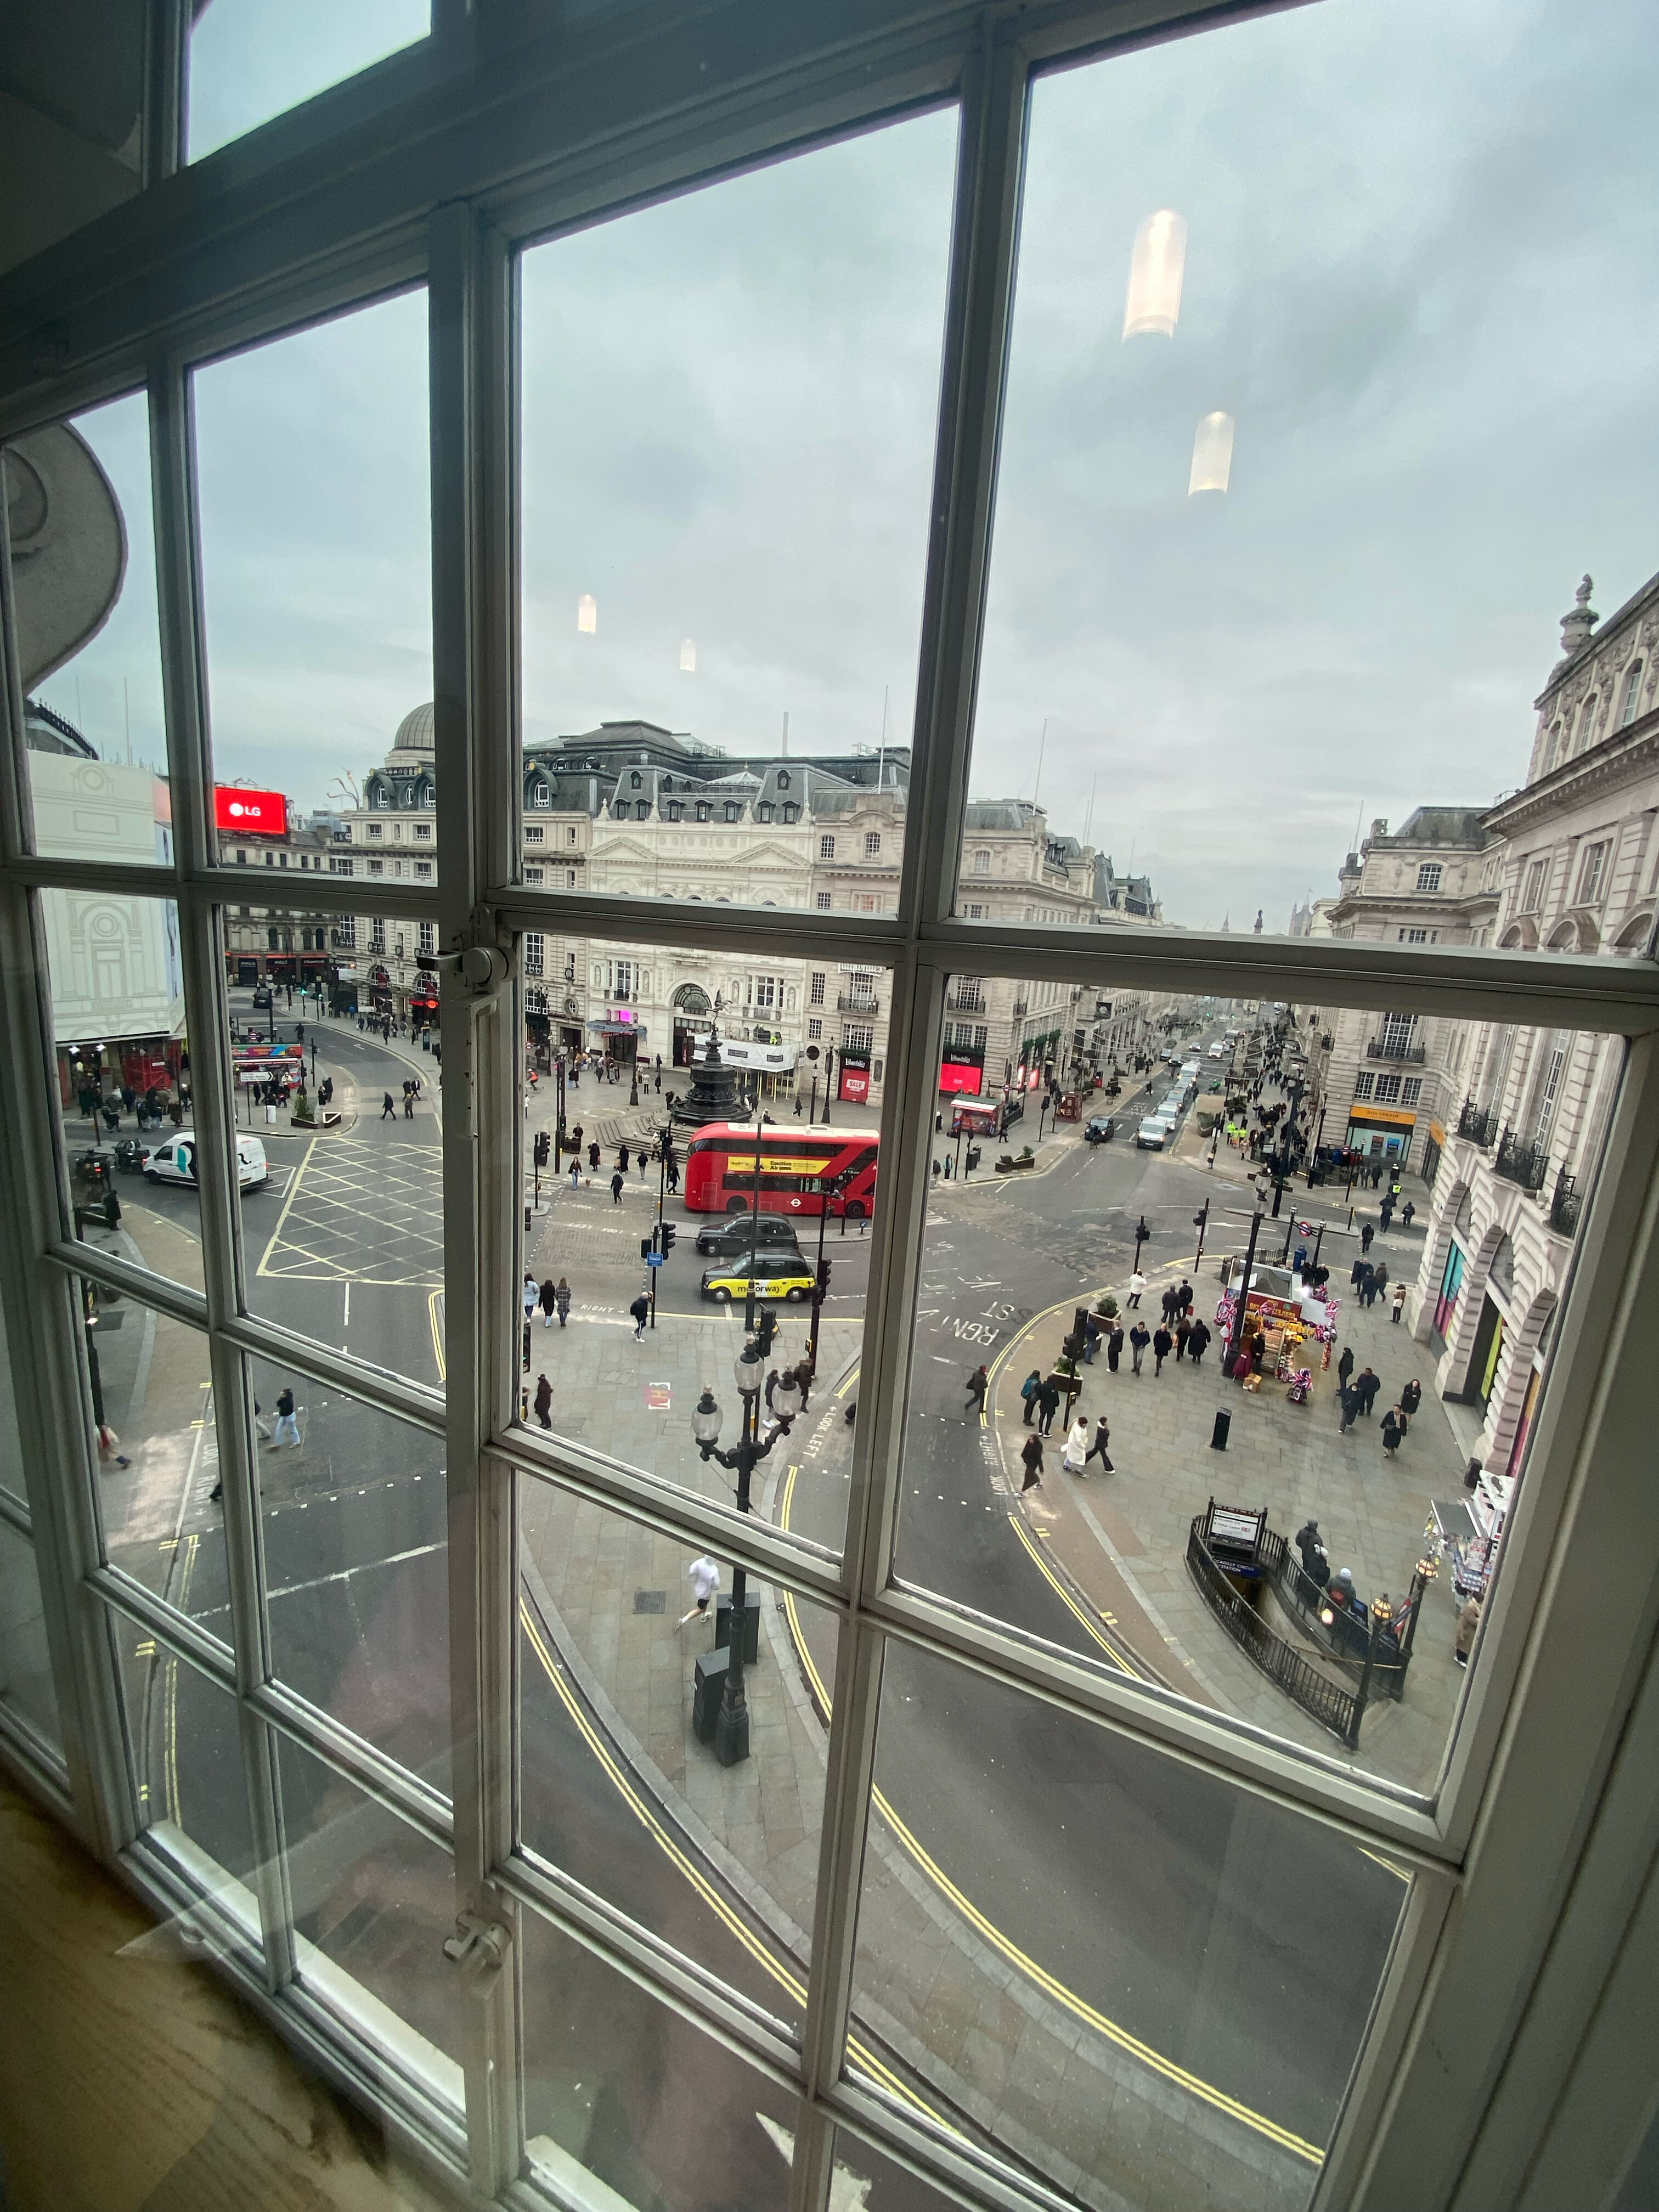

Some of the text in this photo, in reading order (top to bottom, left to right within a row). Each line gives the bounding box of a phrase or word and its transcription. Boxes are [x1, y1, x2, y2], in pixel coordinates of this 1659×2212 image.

[245, 806, 261, 816] LG
[738, 1285, 780, 1294] morway
[580, 1304, 615, 1313] RIGHT
[980, 1301, 1014, 1321] ST
[803, 1412, 836, 1458] LOOK LEFT
[201, 1443, 218, 1467] LOOK
[979, 1441, 1009, 1495] LOOK RIGHT
[1237, 1564, 1255, 1572] CIRCUS
